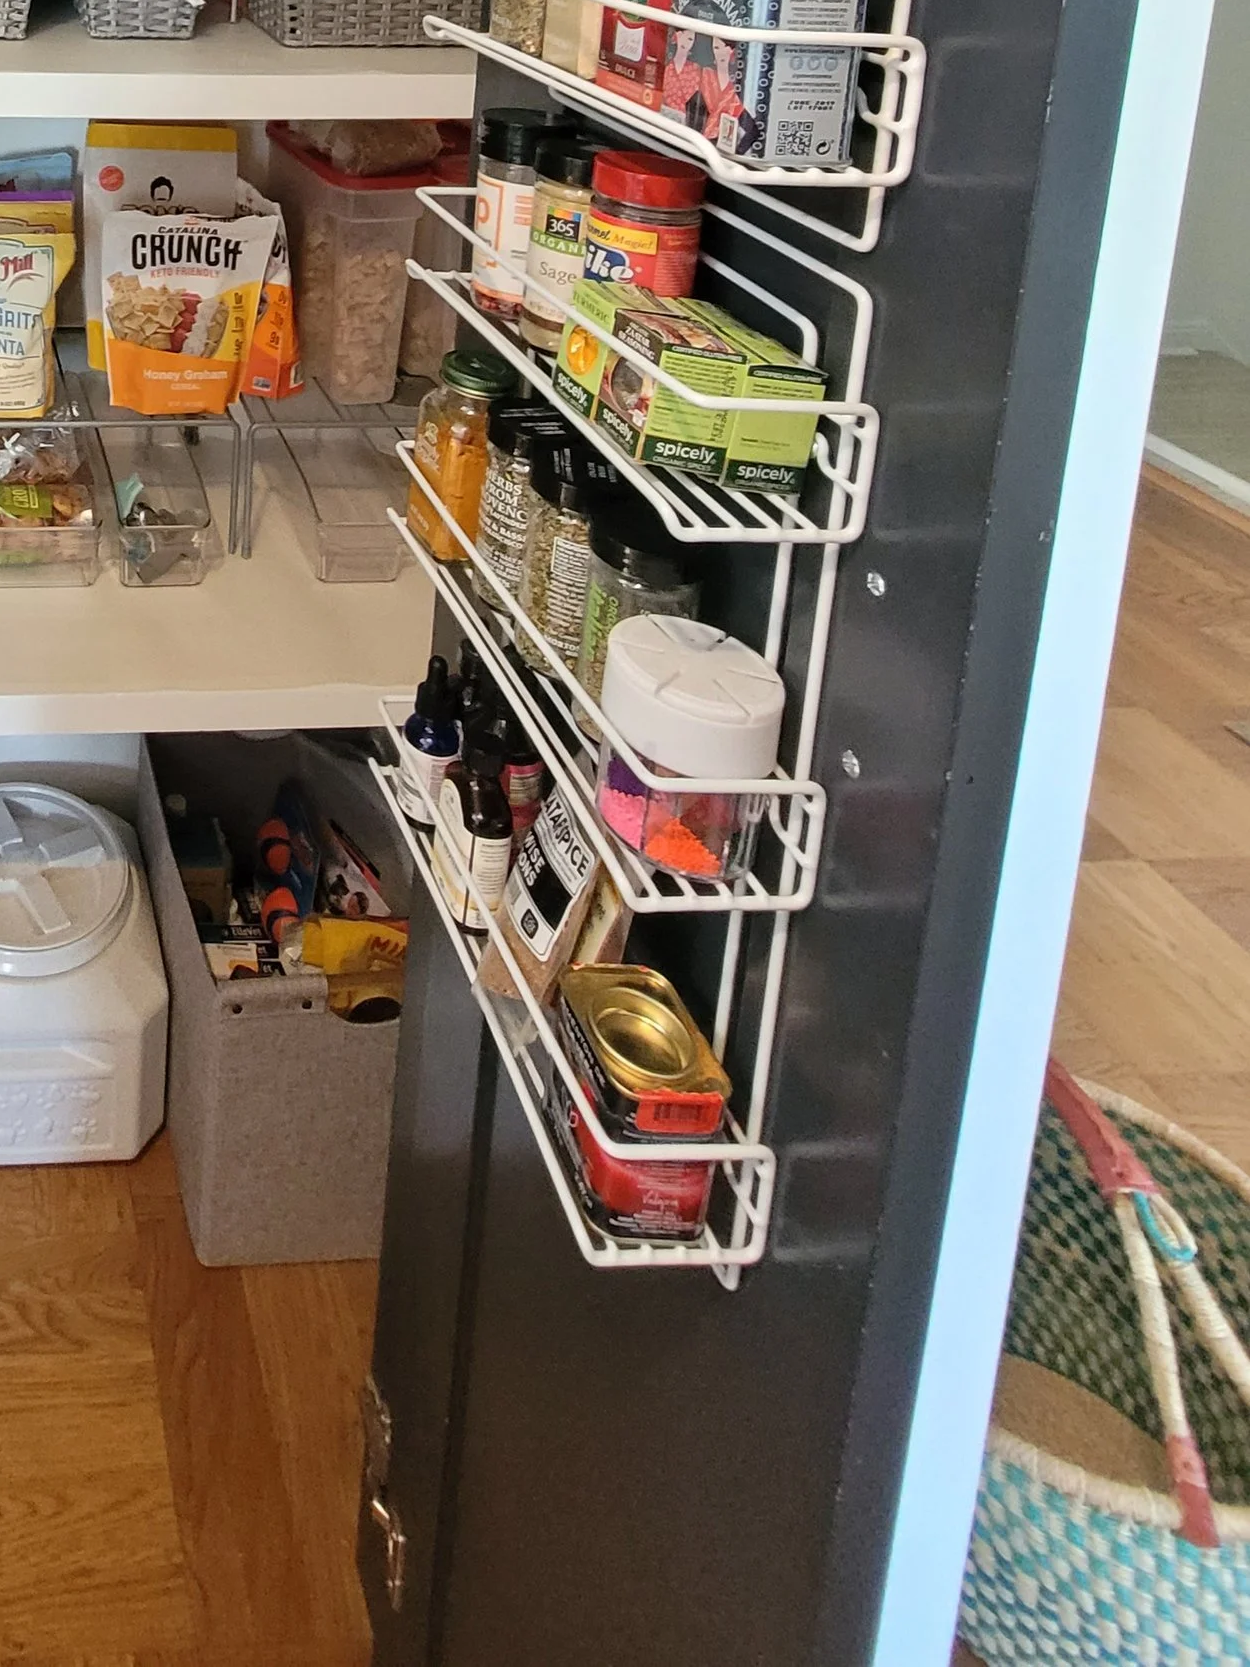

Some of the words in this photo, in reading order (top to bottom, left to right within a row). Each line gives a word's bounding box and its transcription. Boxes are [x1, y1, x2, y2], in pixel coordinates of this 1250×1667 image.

[158, 226, 219, 235] CATALINA
[549, 218, 575, 237] 365
[131, 233, 243, 271] CRUNCH
[150, 268, 173, 279] KETO
[175, 267, 221, 279] FRIENDLY
[539, 261, 578, 284] Sage
[143, 369, 184, 382] Honey
[186, 370, 228, 382] Graham
[557, 371, 588, 405] spicely
[603, 407, 634, 444] spicely
[656, 441, 716, 464] spicely
[738, 464, 795, 484] spicely
[524, 832, 546, 874] WISE
[558, 829, 590, 879] SPICE
